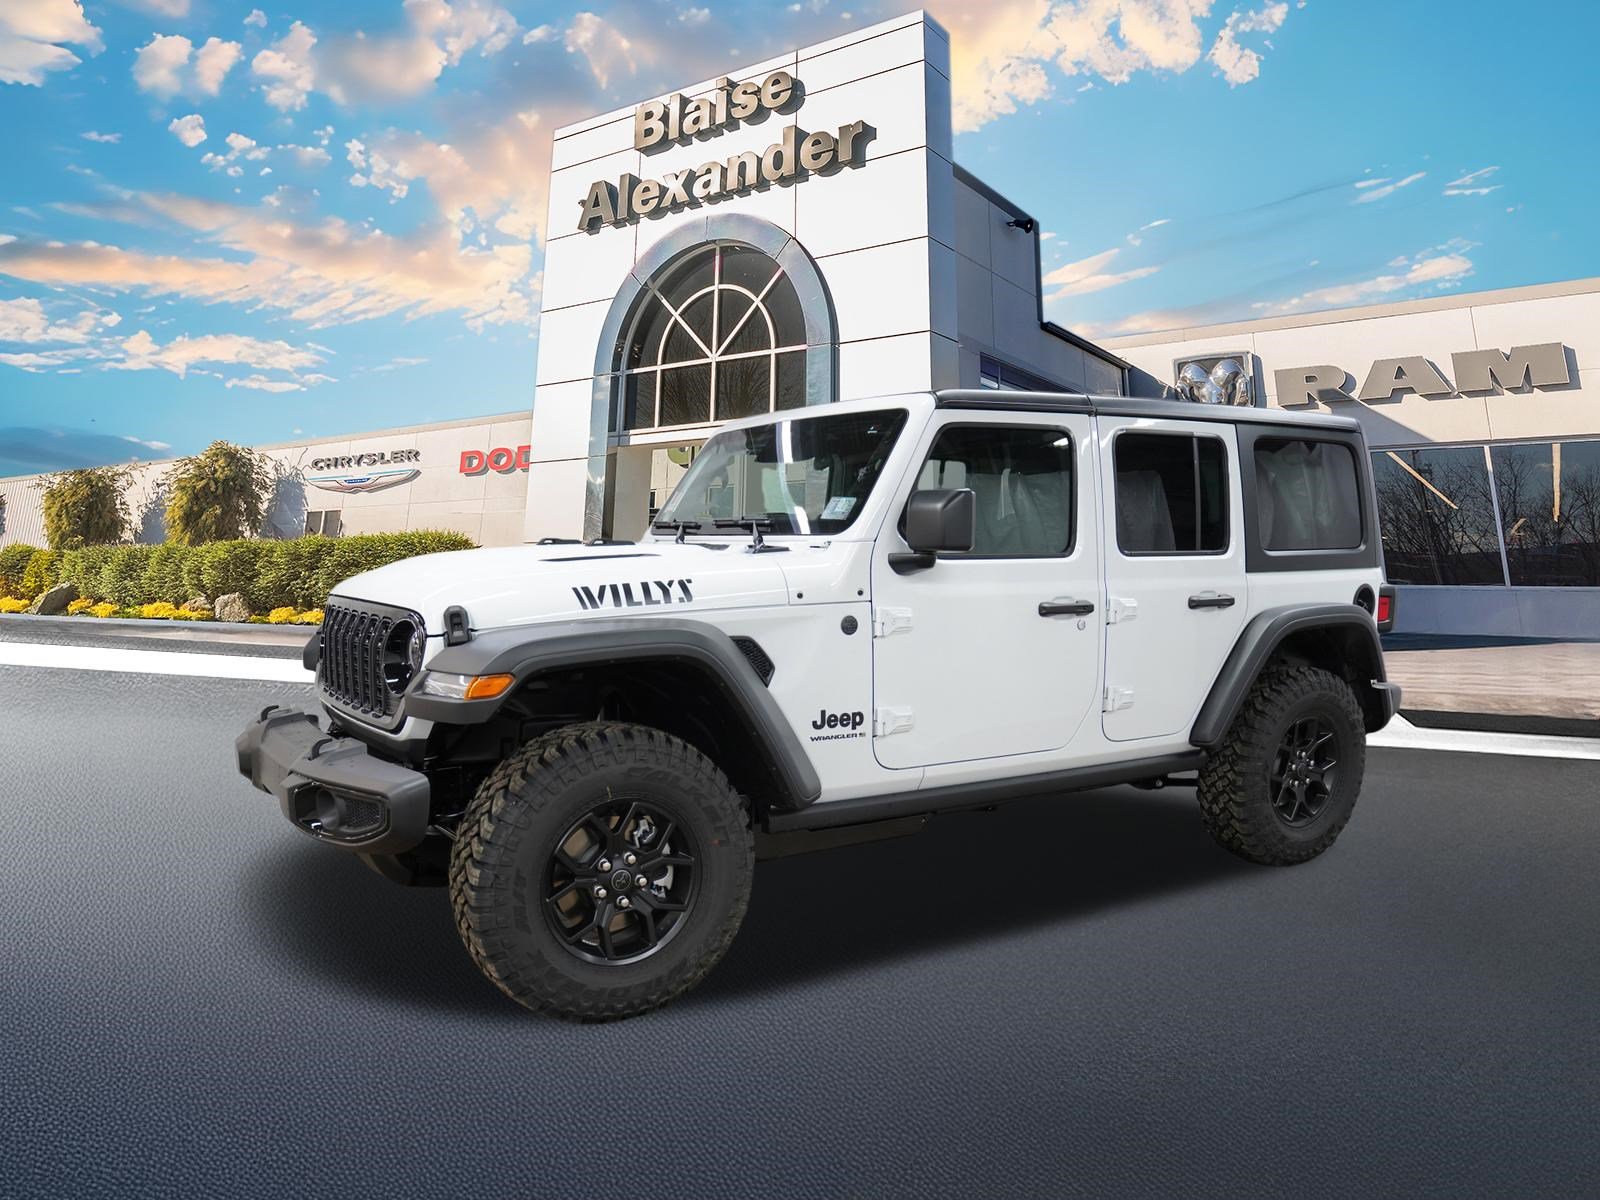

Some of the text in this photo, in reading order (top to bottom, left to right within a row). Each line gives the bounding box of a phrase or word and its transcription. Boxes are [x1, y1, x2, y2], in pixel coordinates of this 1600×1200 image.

[634, 71, 803, 155] Blaise
[578, 119, 874, 233] Alexander
[1274, 342, 1573, 406] RAM
[312, 448, 421, 471] CHRYSLER
[571, 578, 693, 610] WILLYS
[812, 709, 864, 730] Jeep
[810, 732, 858, 742] WRANGLER
